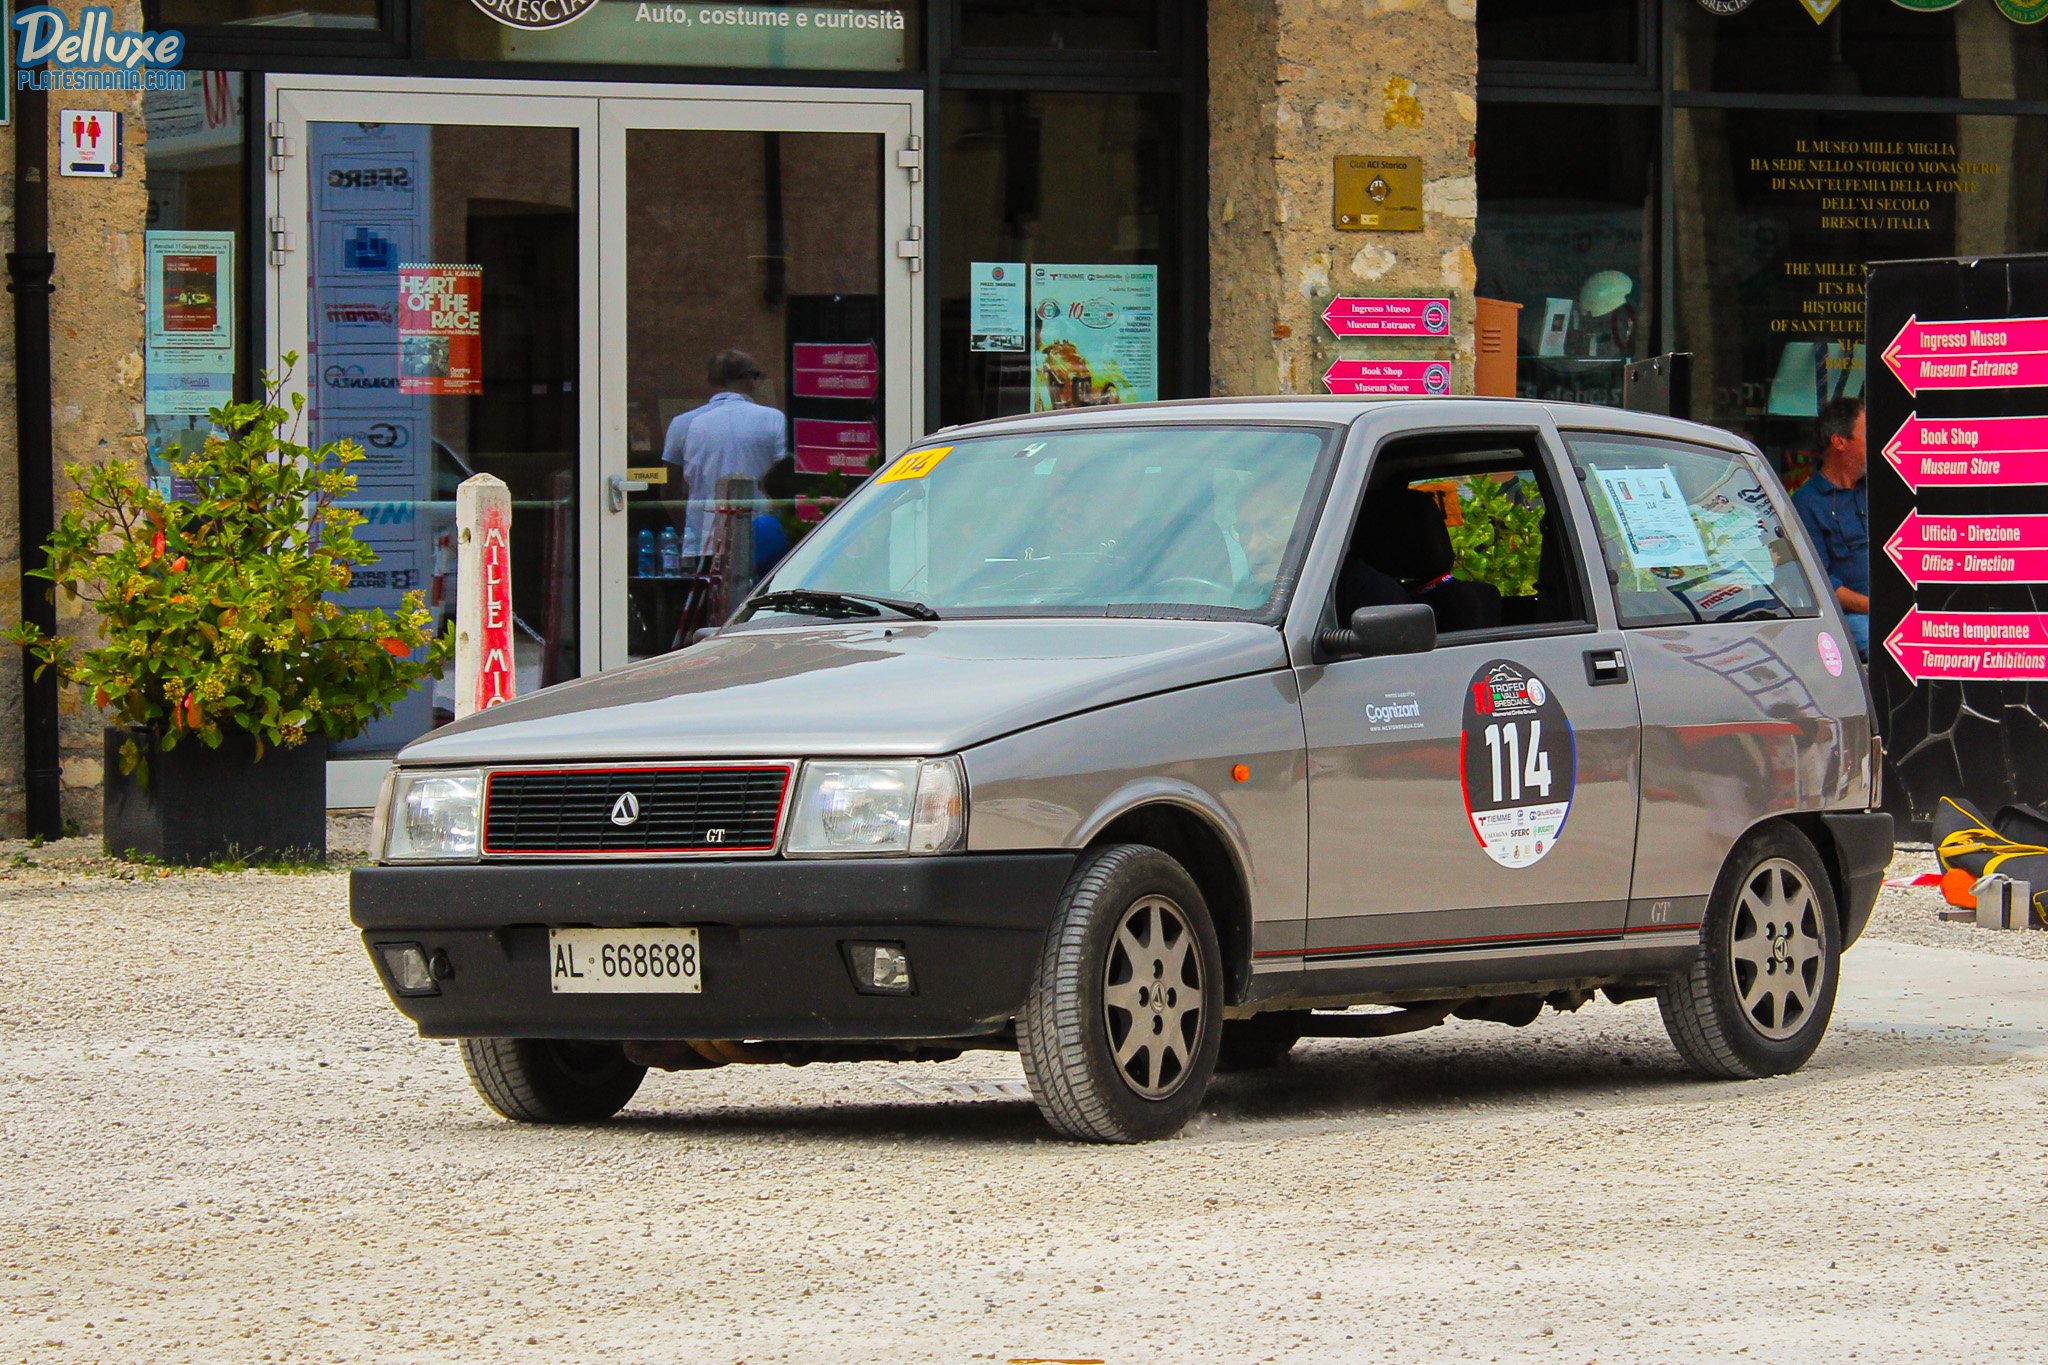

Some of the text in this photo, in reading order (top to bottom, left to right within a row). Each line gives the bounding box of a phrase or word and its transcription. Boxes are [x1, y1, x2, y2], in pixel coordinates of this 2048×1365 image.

[635, 3, 905, 30] Auto, costume e curiosità
[1796, 140, 1955, 156] IL MUSEO MILLE MIGLIA
[1381, 162, 1408, 170] Storico
[1750, 159, 2000, 175] HA SEDE NELLO STORICO MONASTERO
[1772, 178, 1786, 190] DI
[1789, 178, 1887, 192] SANT'EUFEMIA
[1890, 180, 1932, 193] DELLA
[1876, 198, 1930, 212] SECOLO
[1821, 217, 1878, 230] BRESCIA
[1888, 217, 1931, 230] ITALIA
[1784, 262, 1811, 276] THE
[1814, 263, 1856, 276] MILLE
[400, 276, 457, 294] HEART
[408, 294, 468, 312] OF THE
[1351, 304, 1411, 314] Ingresso Museo
[431, 311, 480, 329] RACE
[1346, 320, 1416, 330] Museum Entrance
[1771, 319, 1788, 332] OF
[1920, 330, 2007, 351] Ingresso Museo
[1361, 367, 1403, 378] Book Shop
[1920, 360, 2018, 378] Museum Entrance
[1354, 384, 1410, 393] Museum Store
[1920, 428, 1978, 448] Book Shop
[1920, 458, 2000, 474] Museum Store
[634, 472, 659, 480] TIRARE
[1922, 524, 1958, 542] Ufficio
[1968, 525, 2020, 542] Direzione
[1922, 554, 1954, 572] Office
[1964, 554, 2015, 572] Direction
[484, 528, 507, 629] MILLE
[1922, 620, 2030, 642] Mostre temporanee
[1922, 650, 2046, 672] Temporary Exhibitions
[1490, 682, 1526, 693] TROFEO
[1494, 698, 1530, 708] BRESCIANE
[1501, 692, 1520, 700] VALLI
[1366, 700, 1420, 724] Cognizant
[1484, 720, 1552, 803] 114
[1487, 814, 1512, 823] TIEMME
[706, 828, 726, 844] GT
[1651, 902, 1671, 922] GT
[554, 943, 697, 979] AL 668688
